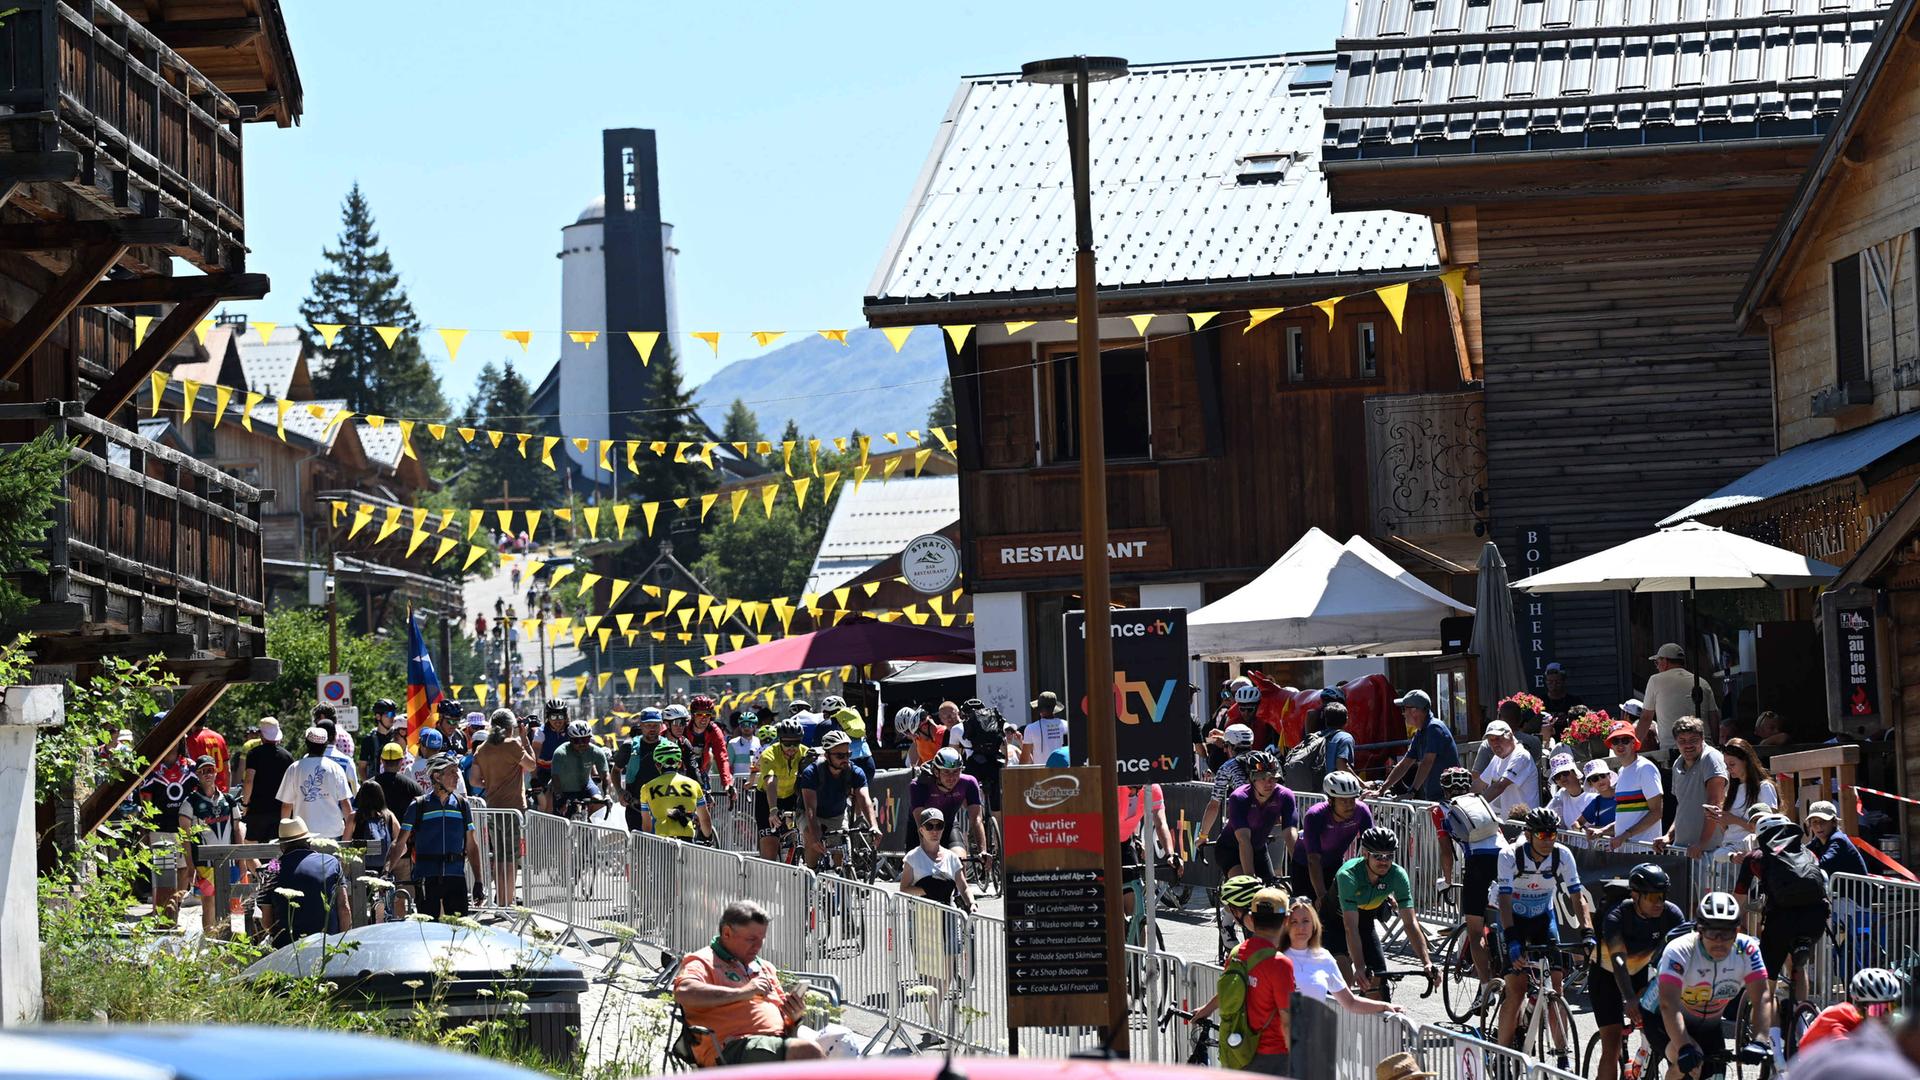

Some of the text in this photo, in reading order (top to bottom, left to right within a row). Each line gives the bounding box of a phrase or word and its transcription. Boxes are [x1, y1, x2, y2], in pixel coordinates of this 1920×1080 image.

[911, 541, 947, 553] STRATO
[1000, 541, 1148, 564] RESTAUANT
[1526, 531, 1545, 688] BOUHERIE
[1848, 640, 1864, 651] au
[1849, 652, 1865, 661] feu
[1850, 662, 1866, 675] de
[1850, 676, 1866, 684] bois
[649, 783, 693, 801] KAS
[1030, 819, 1077, 834] Quartier
[1028, 832, 1080, 846] Vieil Alpe
[1021, 873, 1050, 881] boucherie
[1072, 872, 1086, 881] Alpe
[1017, 889, 1049, 897] Médecine
[1061, 888, 1084, 896] Travail
[1037, 904, 1046, 912] La
[1055, 952, 1075, 960] Sports
[1040, 968, 1058, 977] Shop
[1058, 968, 1089, 976] Boutique
[1070, 983, 1099, 992] Français
